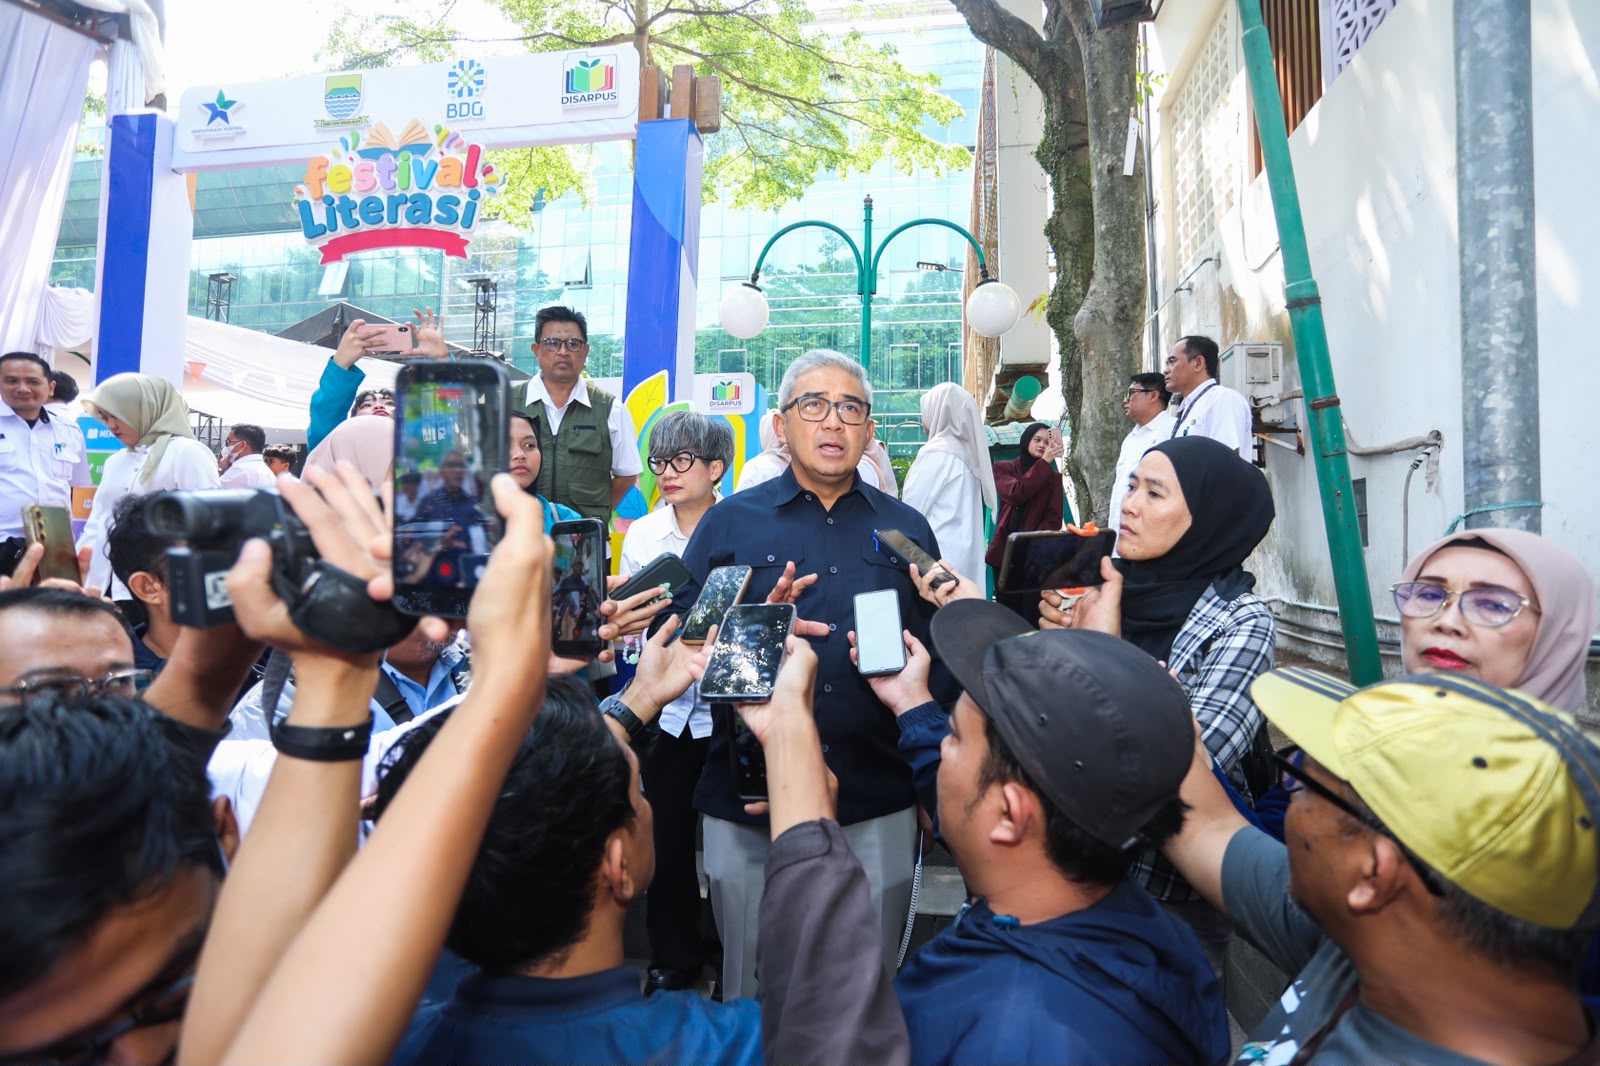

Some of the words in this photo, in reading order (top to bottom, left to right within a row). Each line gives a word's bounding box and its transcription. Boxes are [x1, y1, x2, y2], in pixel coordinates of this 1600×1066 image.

[446, 101, 484, 119] BDG
[561, 91, 617, 105] DISARPUS
[303, 144, 482, 201] festival
[298, 188, 481, 240] Literasi
